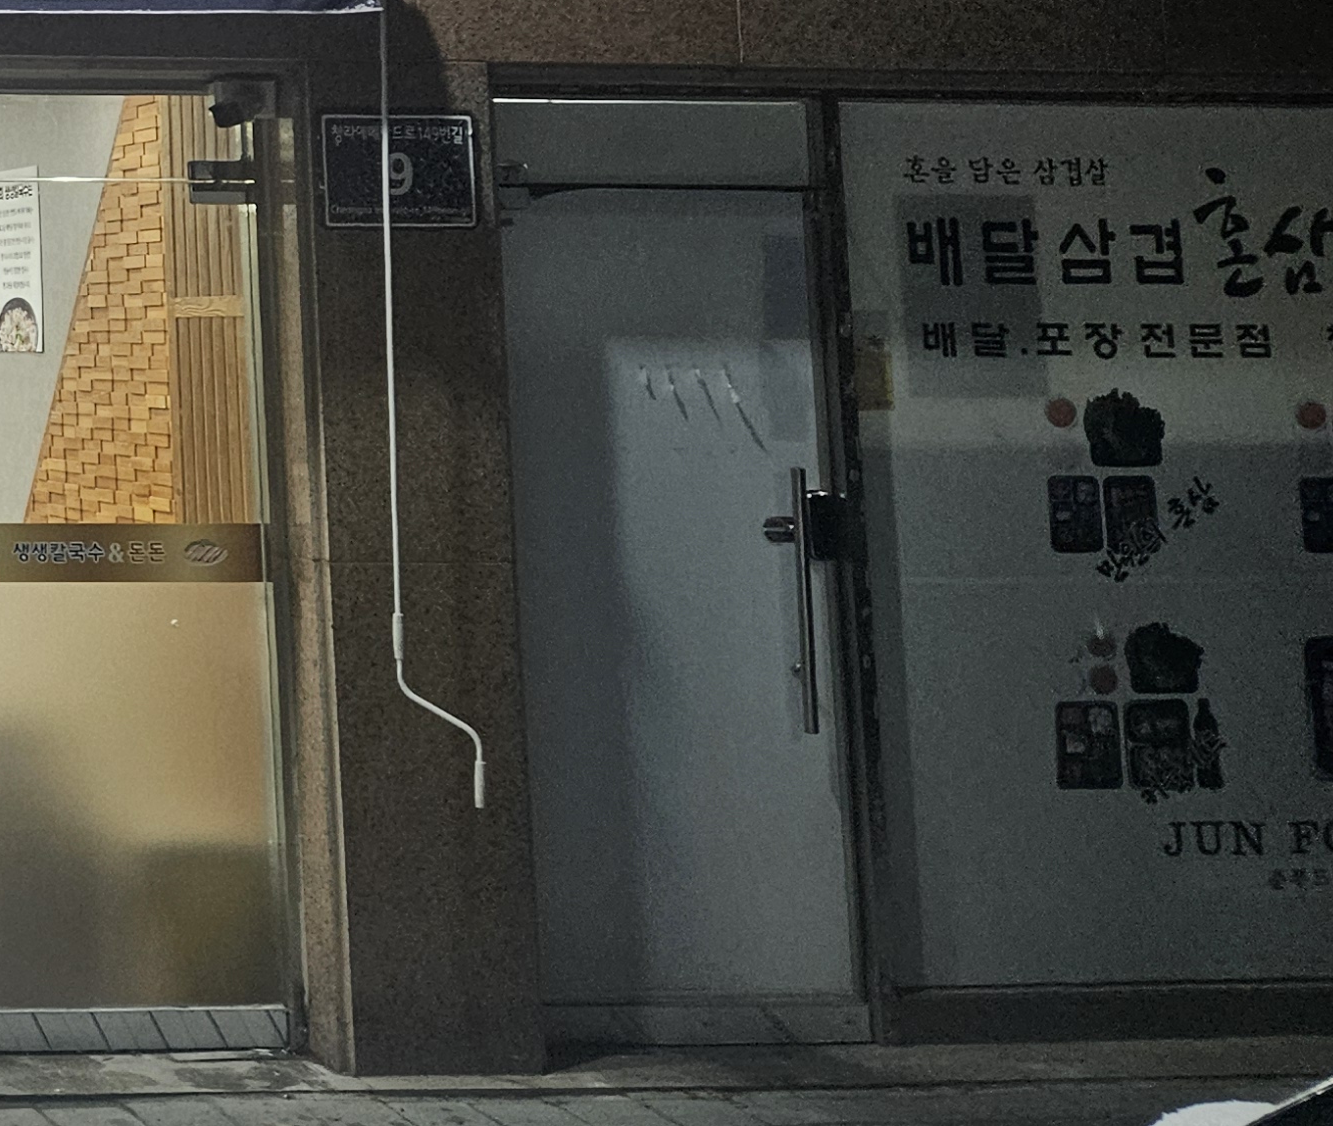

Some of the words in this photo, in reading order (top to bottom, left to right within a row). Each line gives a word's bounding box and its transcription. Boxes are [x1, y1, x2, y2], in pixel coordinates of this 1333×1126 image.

[387, 151, 414, 196] 9
[968, 157, 1022, 186] 담은
[1033, 156, 1109, 187] 삼겹살
[1140, 322, 1273, 360] 전문점
[12, 540, 106, 565] 생생칼국수
[107, 541, 125, 565] &
[127, 540, 167, 565] 돈돈
[1164, 821, 1267, 858] JUN
